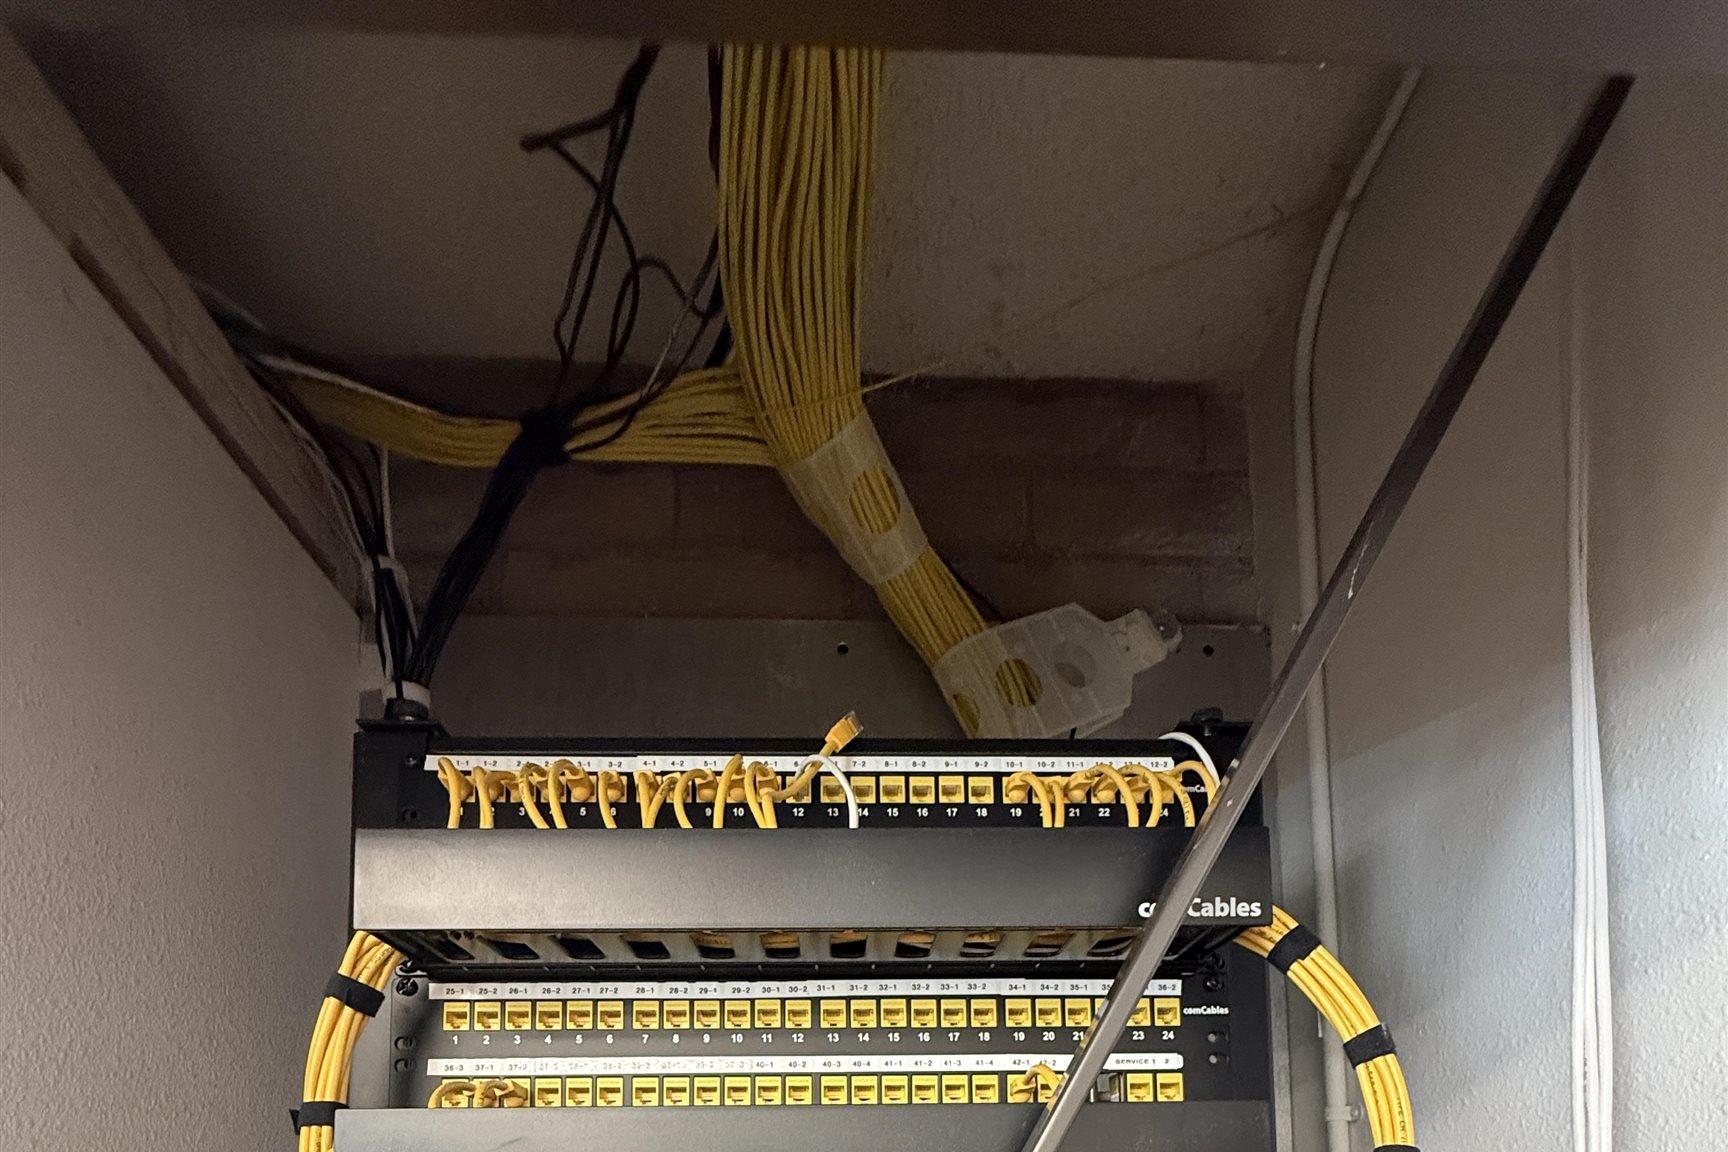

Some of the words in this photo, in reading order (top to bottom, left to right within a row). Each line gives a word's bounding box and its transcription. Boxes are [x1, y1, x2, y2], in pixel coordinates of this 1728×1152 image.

[608, 760, 623, 768] 3-2
[1006, 760, 1023, 768] 10-1
[1037, 760, 1055, 768] 10-2
[518, 807, 526, 816] 3
[579, 807, 587, 816] 5
[610, 807, 617, 816] 6
[705, 807, 712, 817] 9
[732, 807, 745, 817] 10
[792, 807, 805, 817] 12
[827, 807, 840, 817] 13
[857, 807, 869, 817] 14
[887, 808, 899, 817] 15
[916, 808, 929, 817] 16
[946, 808, 958, 817] 17
[976, 808, 988, 817] 18
[1010, 808, 1022, 817] 19
[1069, 808, 1080, 817] 21
[1098, 808, 1111, 817] 22
[1137, 897, 1262, 918] cCables
[446, 987, 464, 995] 25-1
[1183, 1005, 1229, 1015] comCables
[452, 1035, 459, 1044] 1
[482, 1035, 490, 1044] 2
[514, 1035, 521, 1044] 3
[544, 1035, 552, 1044] 4
[575, 1035, 583, 1044] 5
[606, 1035, 614, 1044] 6
[642, 1034, 649, 1043] 7
[672, 1034, 680, 1043] 8
[703, 1034, 710, 1043] 9
[731, 1034, 743, 1043] 10
[761, 1034, 772, 1042] 11
[791, 1034, 804, 1042] 12
[827, 1033, 839, 1042] 13
[857, 1033, 870, 1042] 14
[887, 1033, 900, 1042] 15
[918, 1033, 930, 1042] 16
[948, 1033, 960, 1042] 17
[978, 1032, 990, 1041] 18
[1013, 1032, 1025, 1041] 19
[1043, 1032, 1055, 1041] 20
[1072, 1032, 1084, 1041] 21
[1132, 1031, 1145, 1040] 23
[1162, 1031, 1175, 1040] 24
[755, 1061, 774, 1069] 40-1
[822, 1060, 841, 1068] 40-3
[852, 1060, 871, 1068] 40-4
[914, 1059, 933, 1067] 41-2
[1012, 1058, 1030, 1066] 42-1
